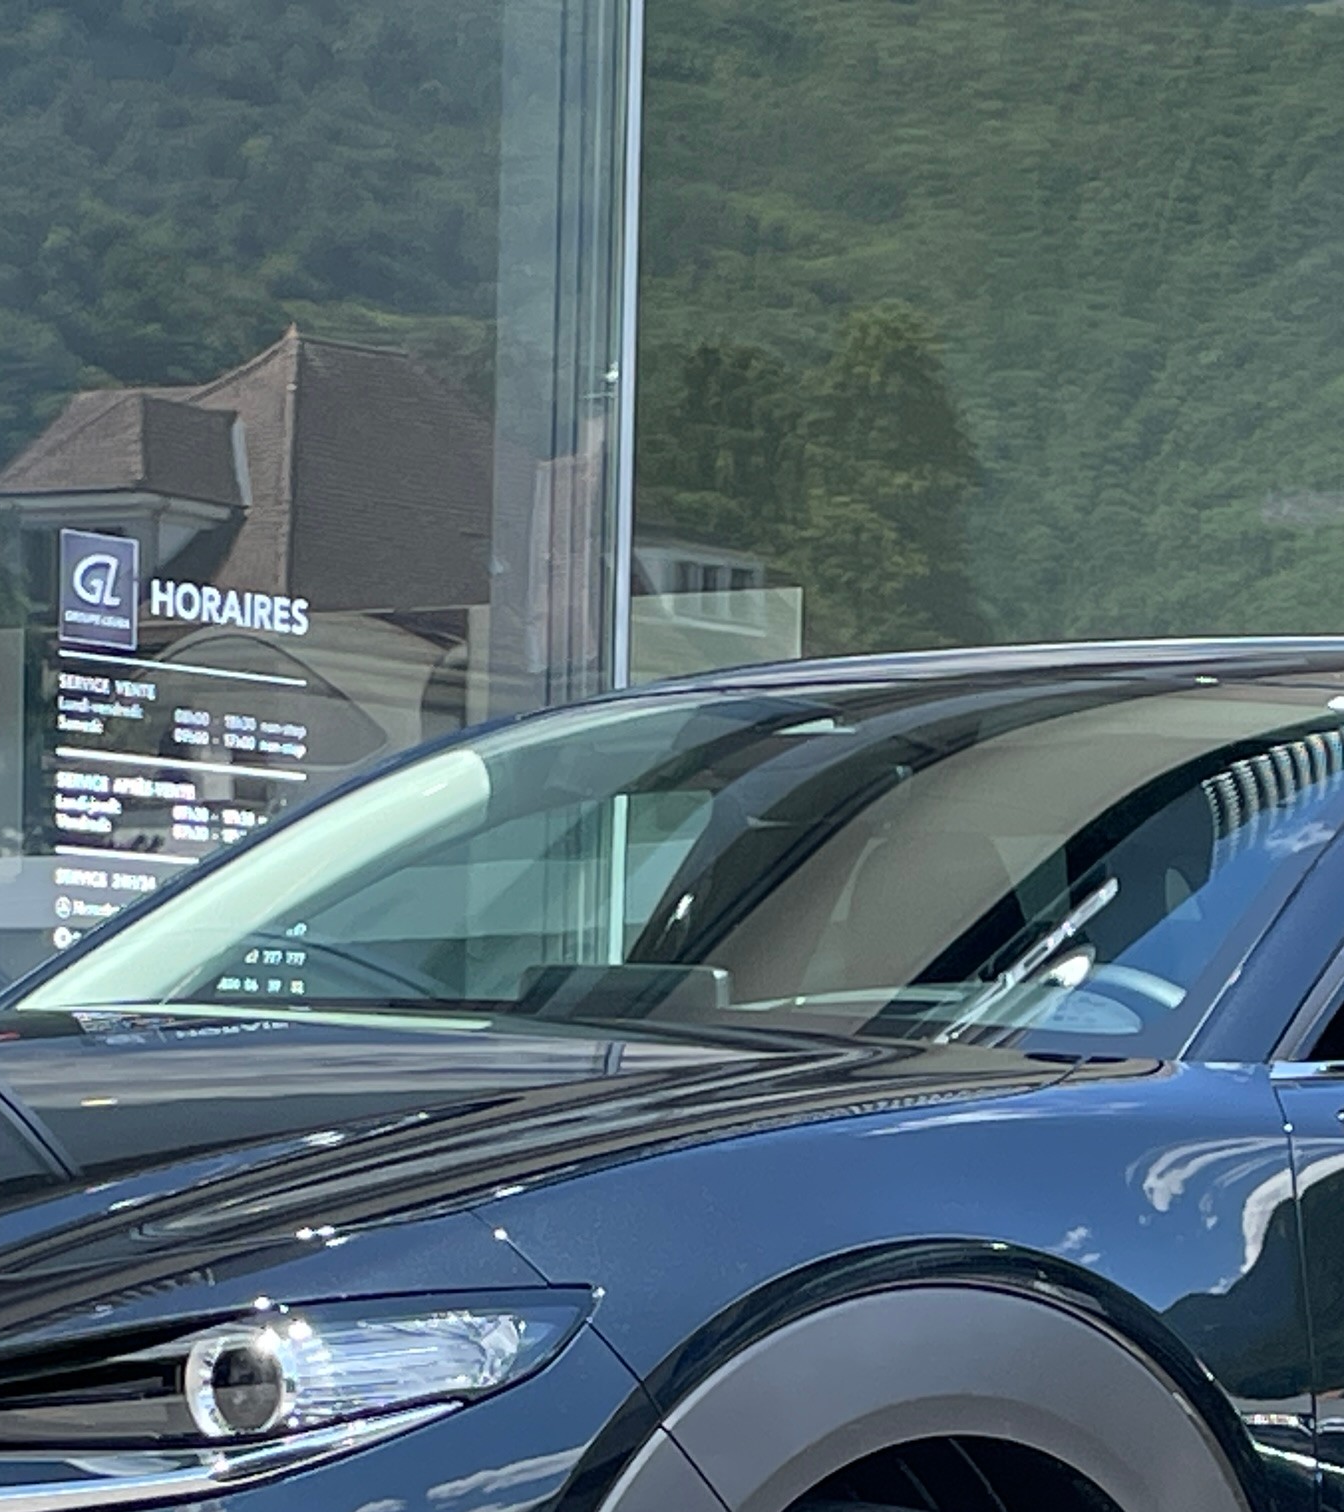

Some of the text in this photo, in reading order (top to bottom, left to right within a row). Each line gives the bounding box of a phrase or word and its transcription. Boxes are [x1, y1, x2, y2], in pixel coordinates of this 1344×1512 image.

[73, 553, 122, 607] GL
[150, 578, 309, 636] HORAIRES
[58, 671, 157, 702] SERVICE VENTE
[55, 770, 110, 794] SERVICE
[54, 867, 108, 889] SERVICE
